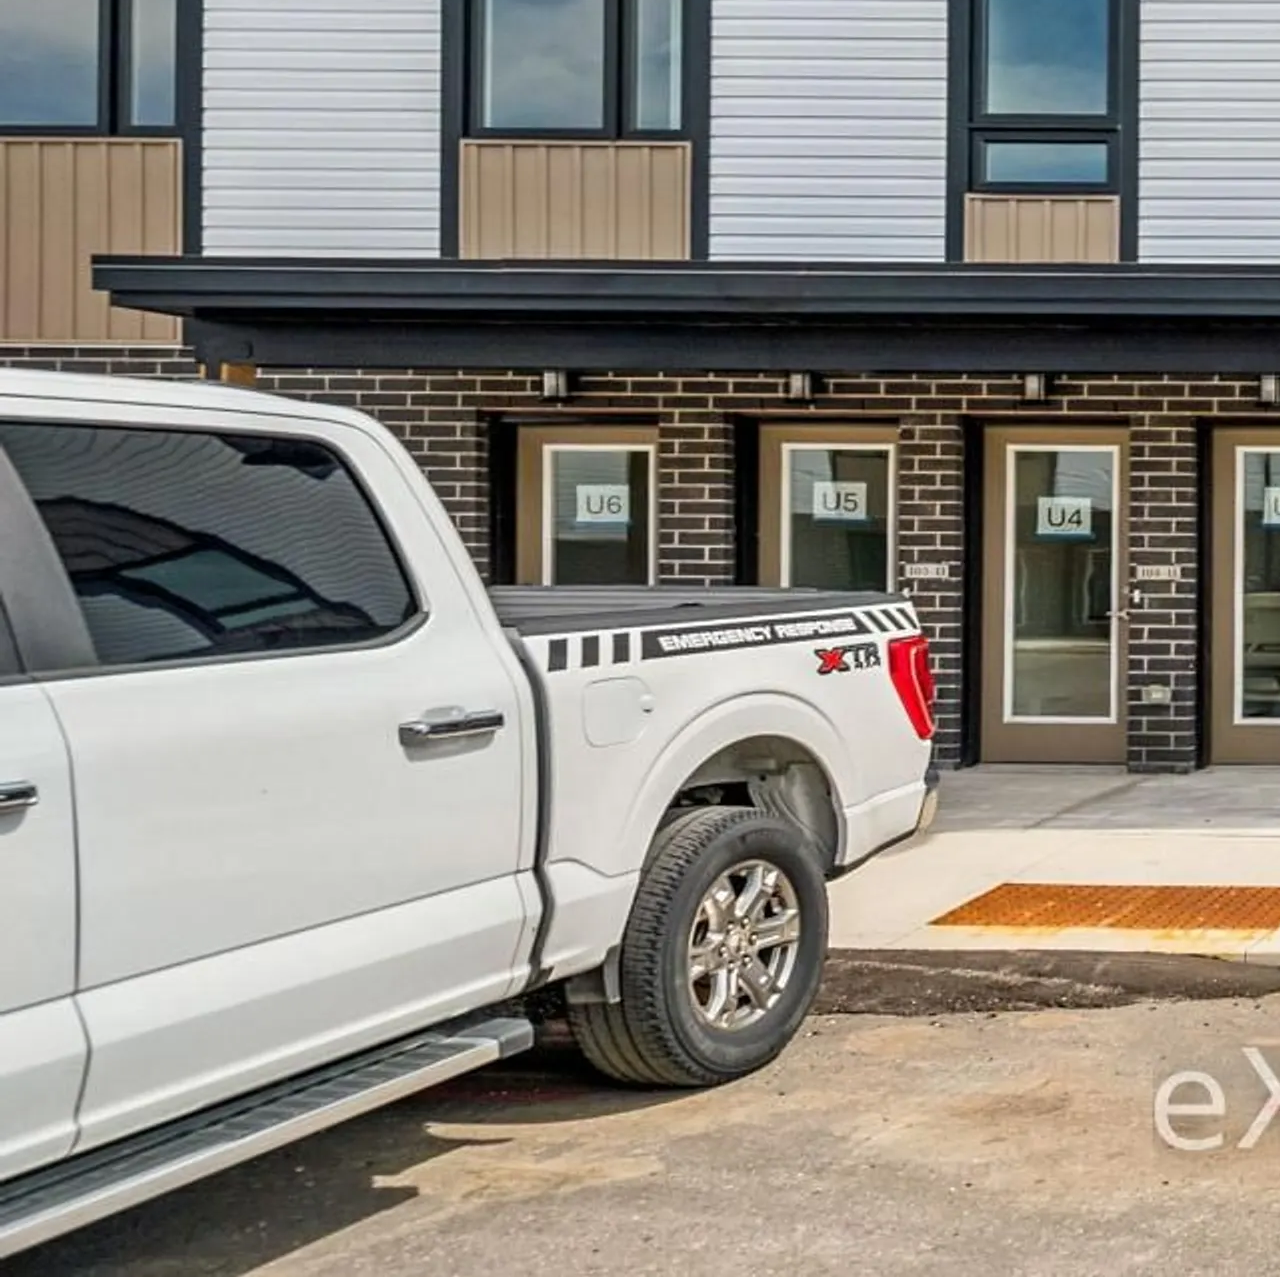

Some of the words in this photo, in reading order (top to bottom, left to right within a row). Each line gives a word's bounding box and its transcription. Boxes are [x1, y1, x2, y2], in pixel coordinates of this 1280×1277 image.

[586, 494, 622, 514] U6
[823, 491, 858, 512] U5
[1048, 507, 1082, 528] U4
[657, 625, 773, 652] EMERGENCY
[774, 618, 857, 639] RESPONSE
[814, 642, 881, 675] XTR
